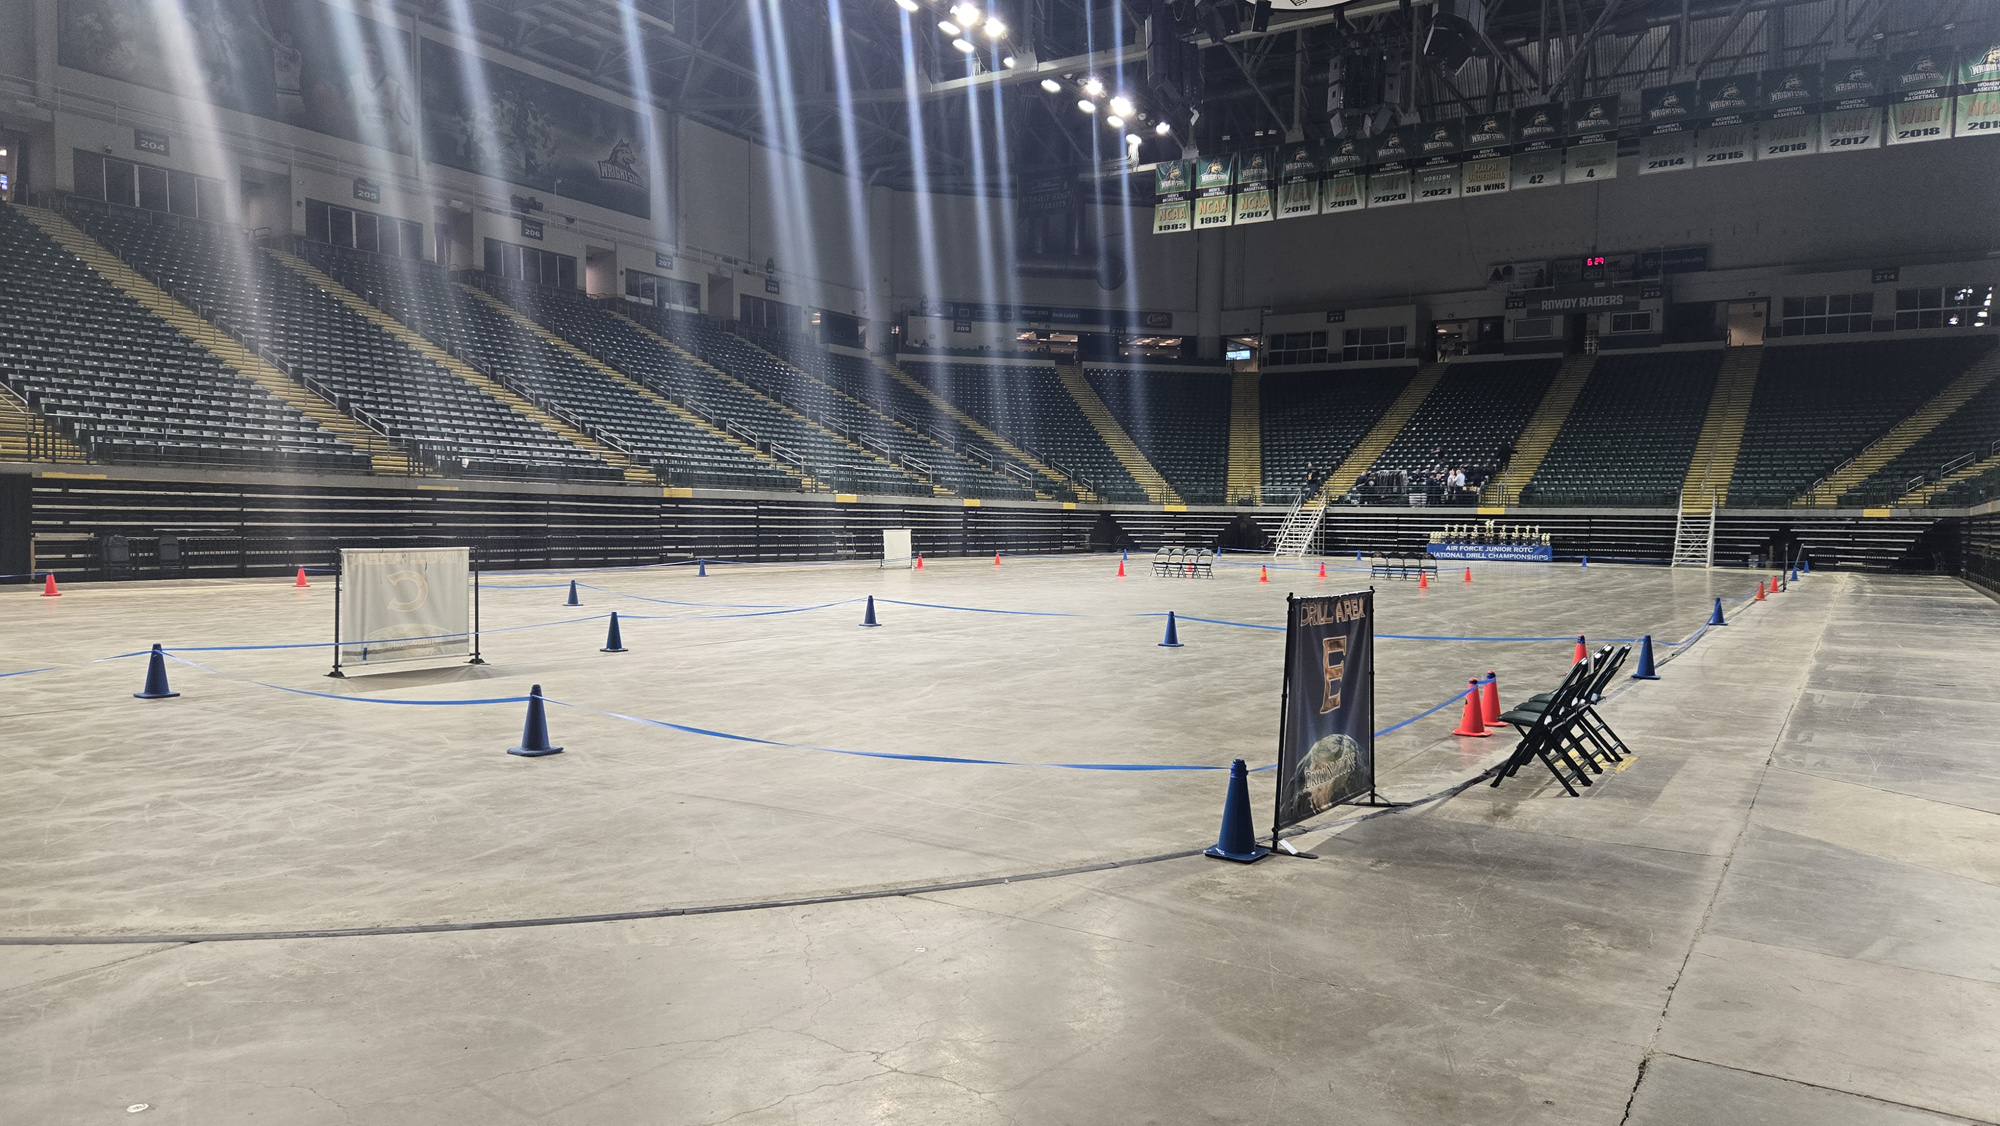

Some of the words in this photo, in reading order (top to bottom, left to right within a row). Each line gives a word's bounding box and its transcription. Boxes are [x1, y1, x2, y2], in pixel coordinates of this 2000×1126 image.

[1972, 64, 1997, 76] WRIGHT
[1901, 73, 1926, 84] WRIGHT
[1835, 82, 1857, 93] WRIGHT
[1770, 91, 1793, 102] WRIGHT
[1904, 92, 1939, 101] BASKETBALL
[1709, 100, 1731, 111] WRIGHT
[1836, 102, 1869, 110] BASKETBALL
[1651, 109, 1671, 119] WRIGHT
[1774, 110, 1805, 118] BASKETBALL
[1900, 105, 1942, 125] WNIT
[1712, 119, 1742, 127] BASKETBALL
[1829, 115, 1872, 132] WNIT
[1967, 120, 2000, 131] 201
[1653, 126, 1683, 135] BASKETBALL
[1899, 127, 1940, 139] 2018
[140, 140, 165, 152] 204
[1830, 136, 1870, 147] 2017
[1768, 142, 1807, 154] 2016
[1707, 151, 1744, 162] 2015
[1474, 163, 1497, 173] RALPH
[1648, 157, 1686, 169] 2014
[600, 161, 628, 181] WRIGHT
[1586, 168, 1595, 178] 4
[1424, 174, 1450, 182] HORIZON
[1468, 171, 1505, 183] UNDERHILL
[1529, 174, 1544, 184] 42
[1335, 183, 1354, 198] NIT
[1422, 187, 1452, 197] 2021
[1466, 185, 1481, 193] 356
[1484, 182, 1506, 191] WINS
[357, 190, 377, 200] 205
[1374, 193, 1406, 203] 2020
[1199, 199, 1228, 214] NCAA
[1240, 195, 1269, 210] NCAA
[1159, 207, 1187, 221] NCAA
[1285, 205, 1311, 213] 2018
[1200, 215, 1227, 225] 1993
[1239, 210, 1270, 220] 2007
[1158, 223, 1187, 231] 1983
[524, 228, 541, 238] 206
[1682, 256, 1704, 264] Health
[1875, 273, 1895, 281] 214
[1541, 298, 1578, 310] ROWDY
[1579, 295, 1624, 308] RAIDERS
[1488, 553, 1549, 561] CHAMPIONSHIPS
[1300, 602, 1334, 627] DRILL
[1335, 597, 1366, 623] AREA
[1319, 635, 1347, 715] E
